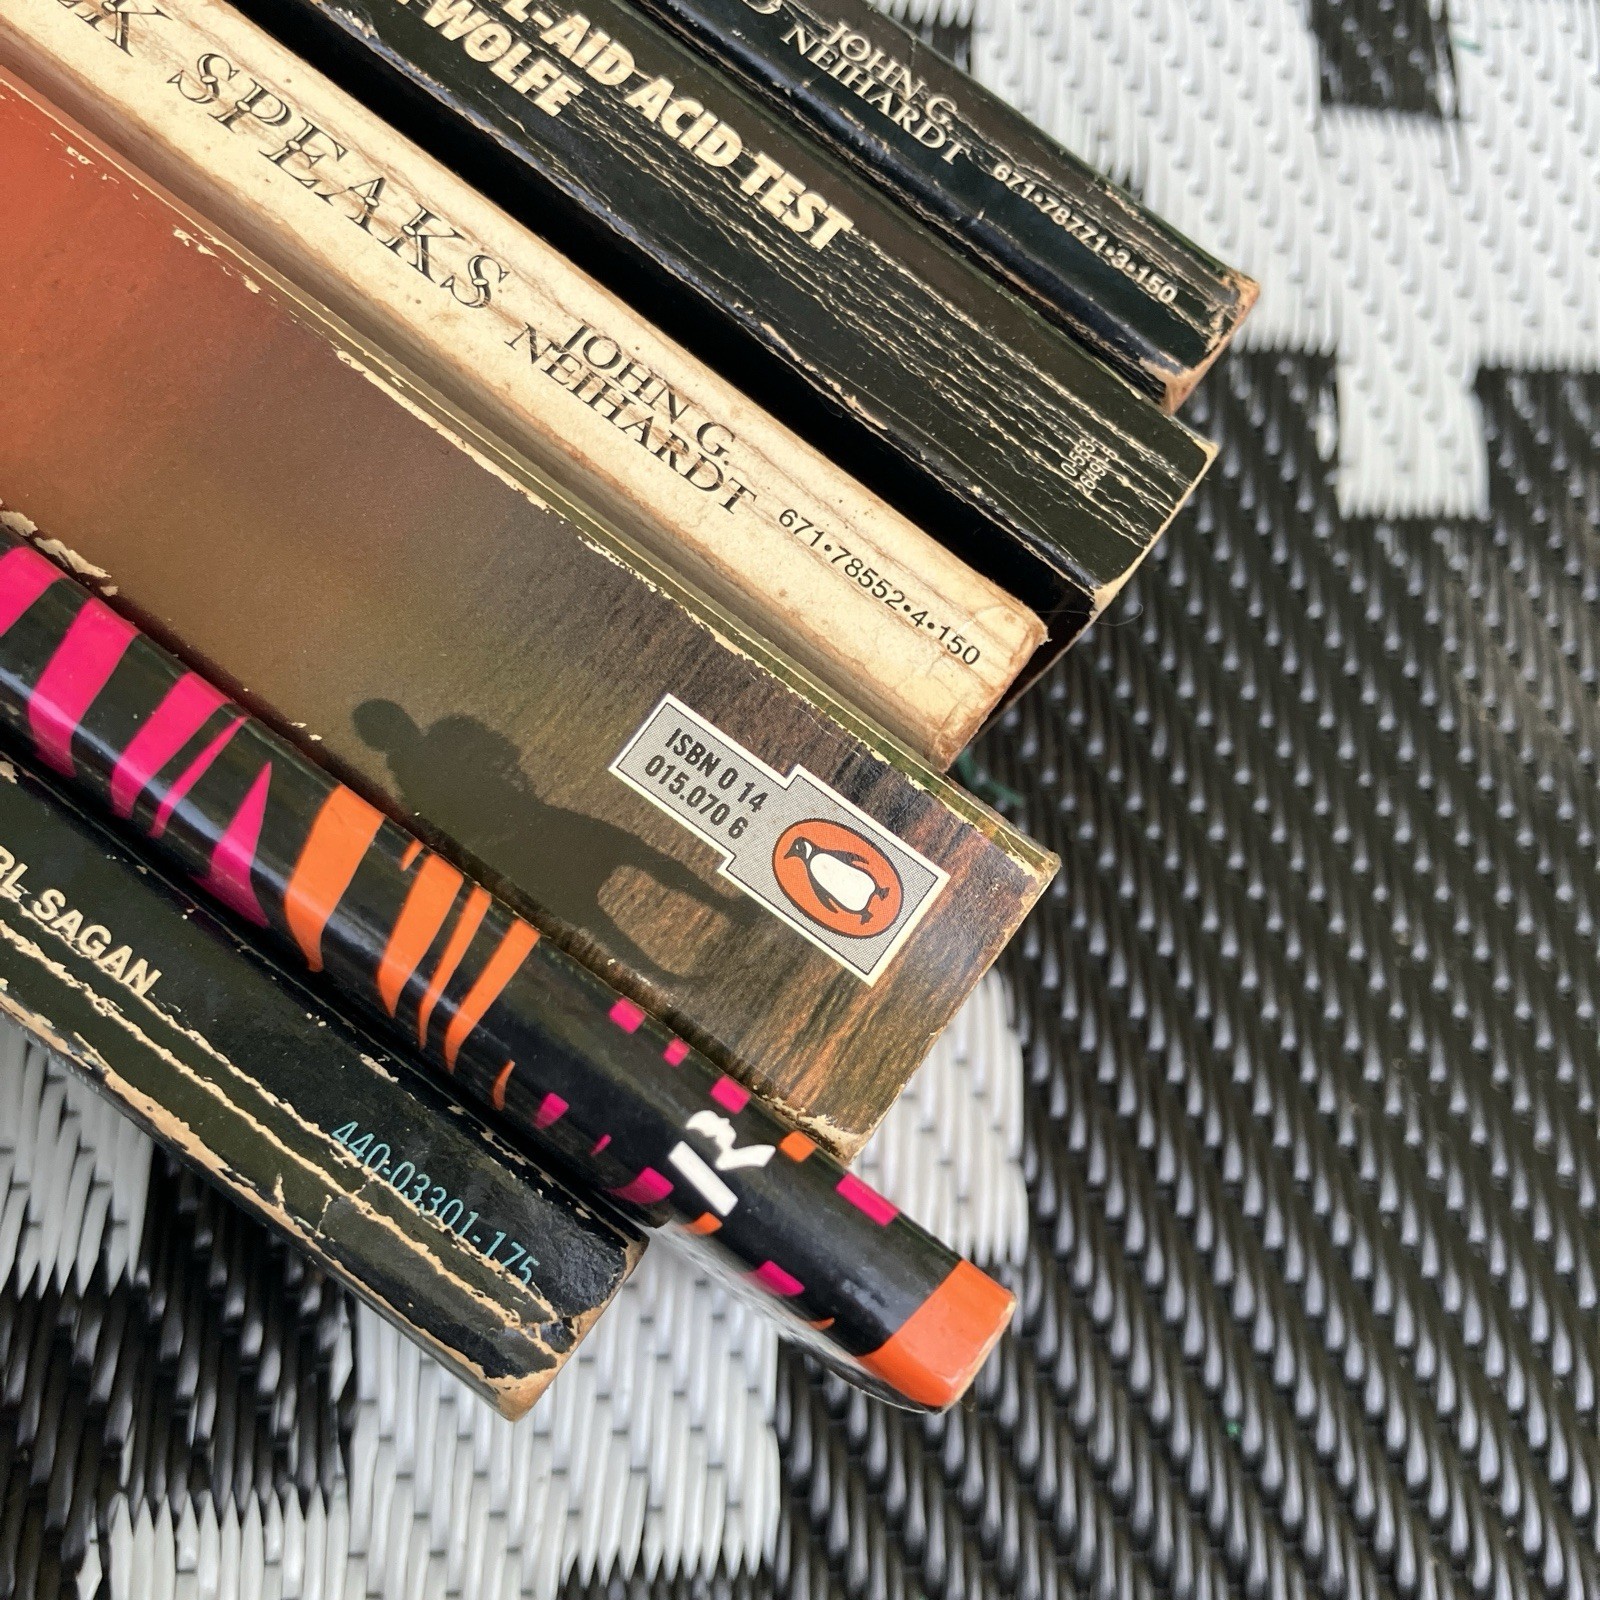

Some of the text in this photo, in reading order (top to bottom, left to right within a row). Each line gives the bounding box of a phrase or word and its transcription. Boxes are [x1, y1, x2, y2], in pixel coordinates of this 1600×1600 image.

[423, 0, 583, 117] WOLFE
[780, 23, 972, 166] NEIHARDT
[821, 21, 958, 131] JOHN G.
[166, 52, 511, 309] SPEAKS
[625, 75, 744, 167] ACID
[740, 151, 854, 251] TEST
[503, 322, 757, 516] NEIHARDT
[557, 319, 740, 466] JOHN G.
[645, 755, 749, 840] 015.070 6
[665, 728, 769, 813] ISBN 0 14
[32, 889, 162, 997] SAGAN
[331, 1121, 540, 1285] 440-03301-175
